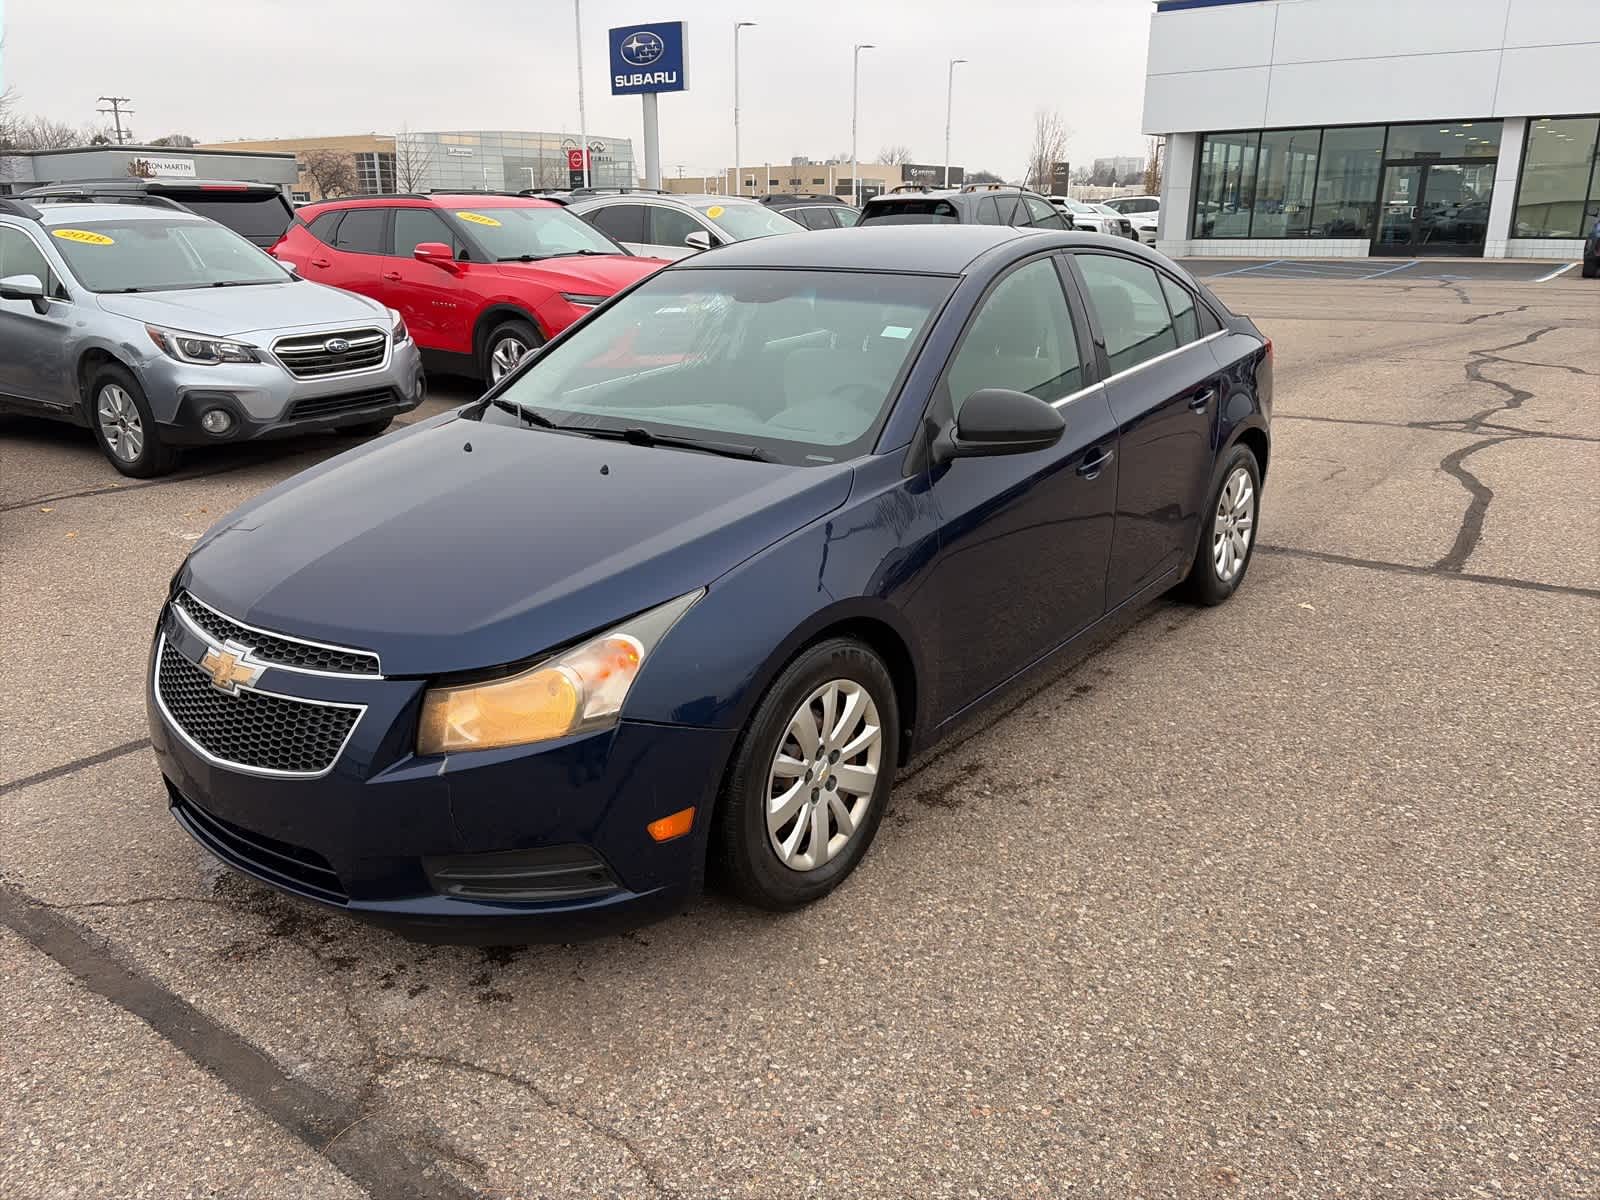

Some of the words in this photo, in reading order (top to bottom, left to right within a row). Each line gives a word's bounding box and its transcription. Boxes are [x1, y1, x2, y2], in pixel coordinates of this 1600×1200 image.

[615, 72, 677, 87] SUBARU
[164, 163, 191, 171] MARTIN
[60, 231, 105, 242] 2018
